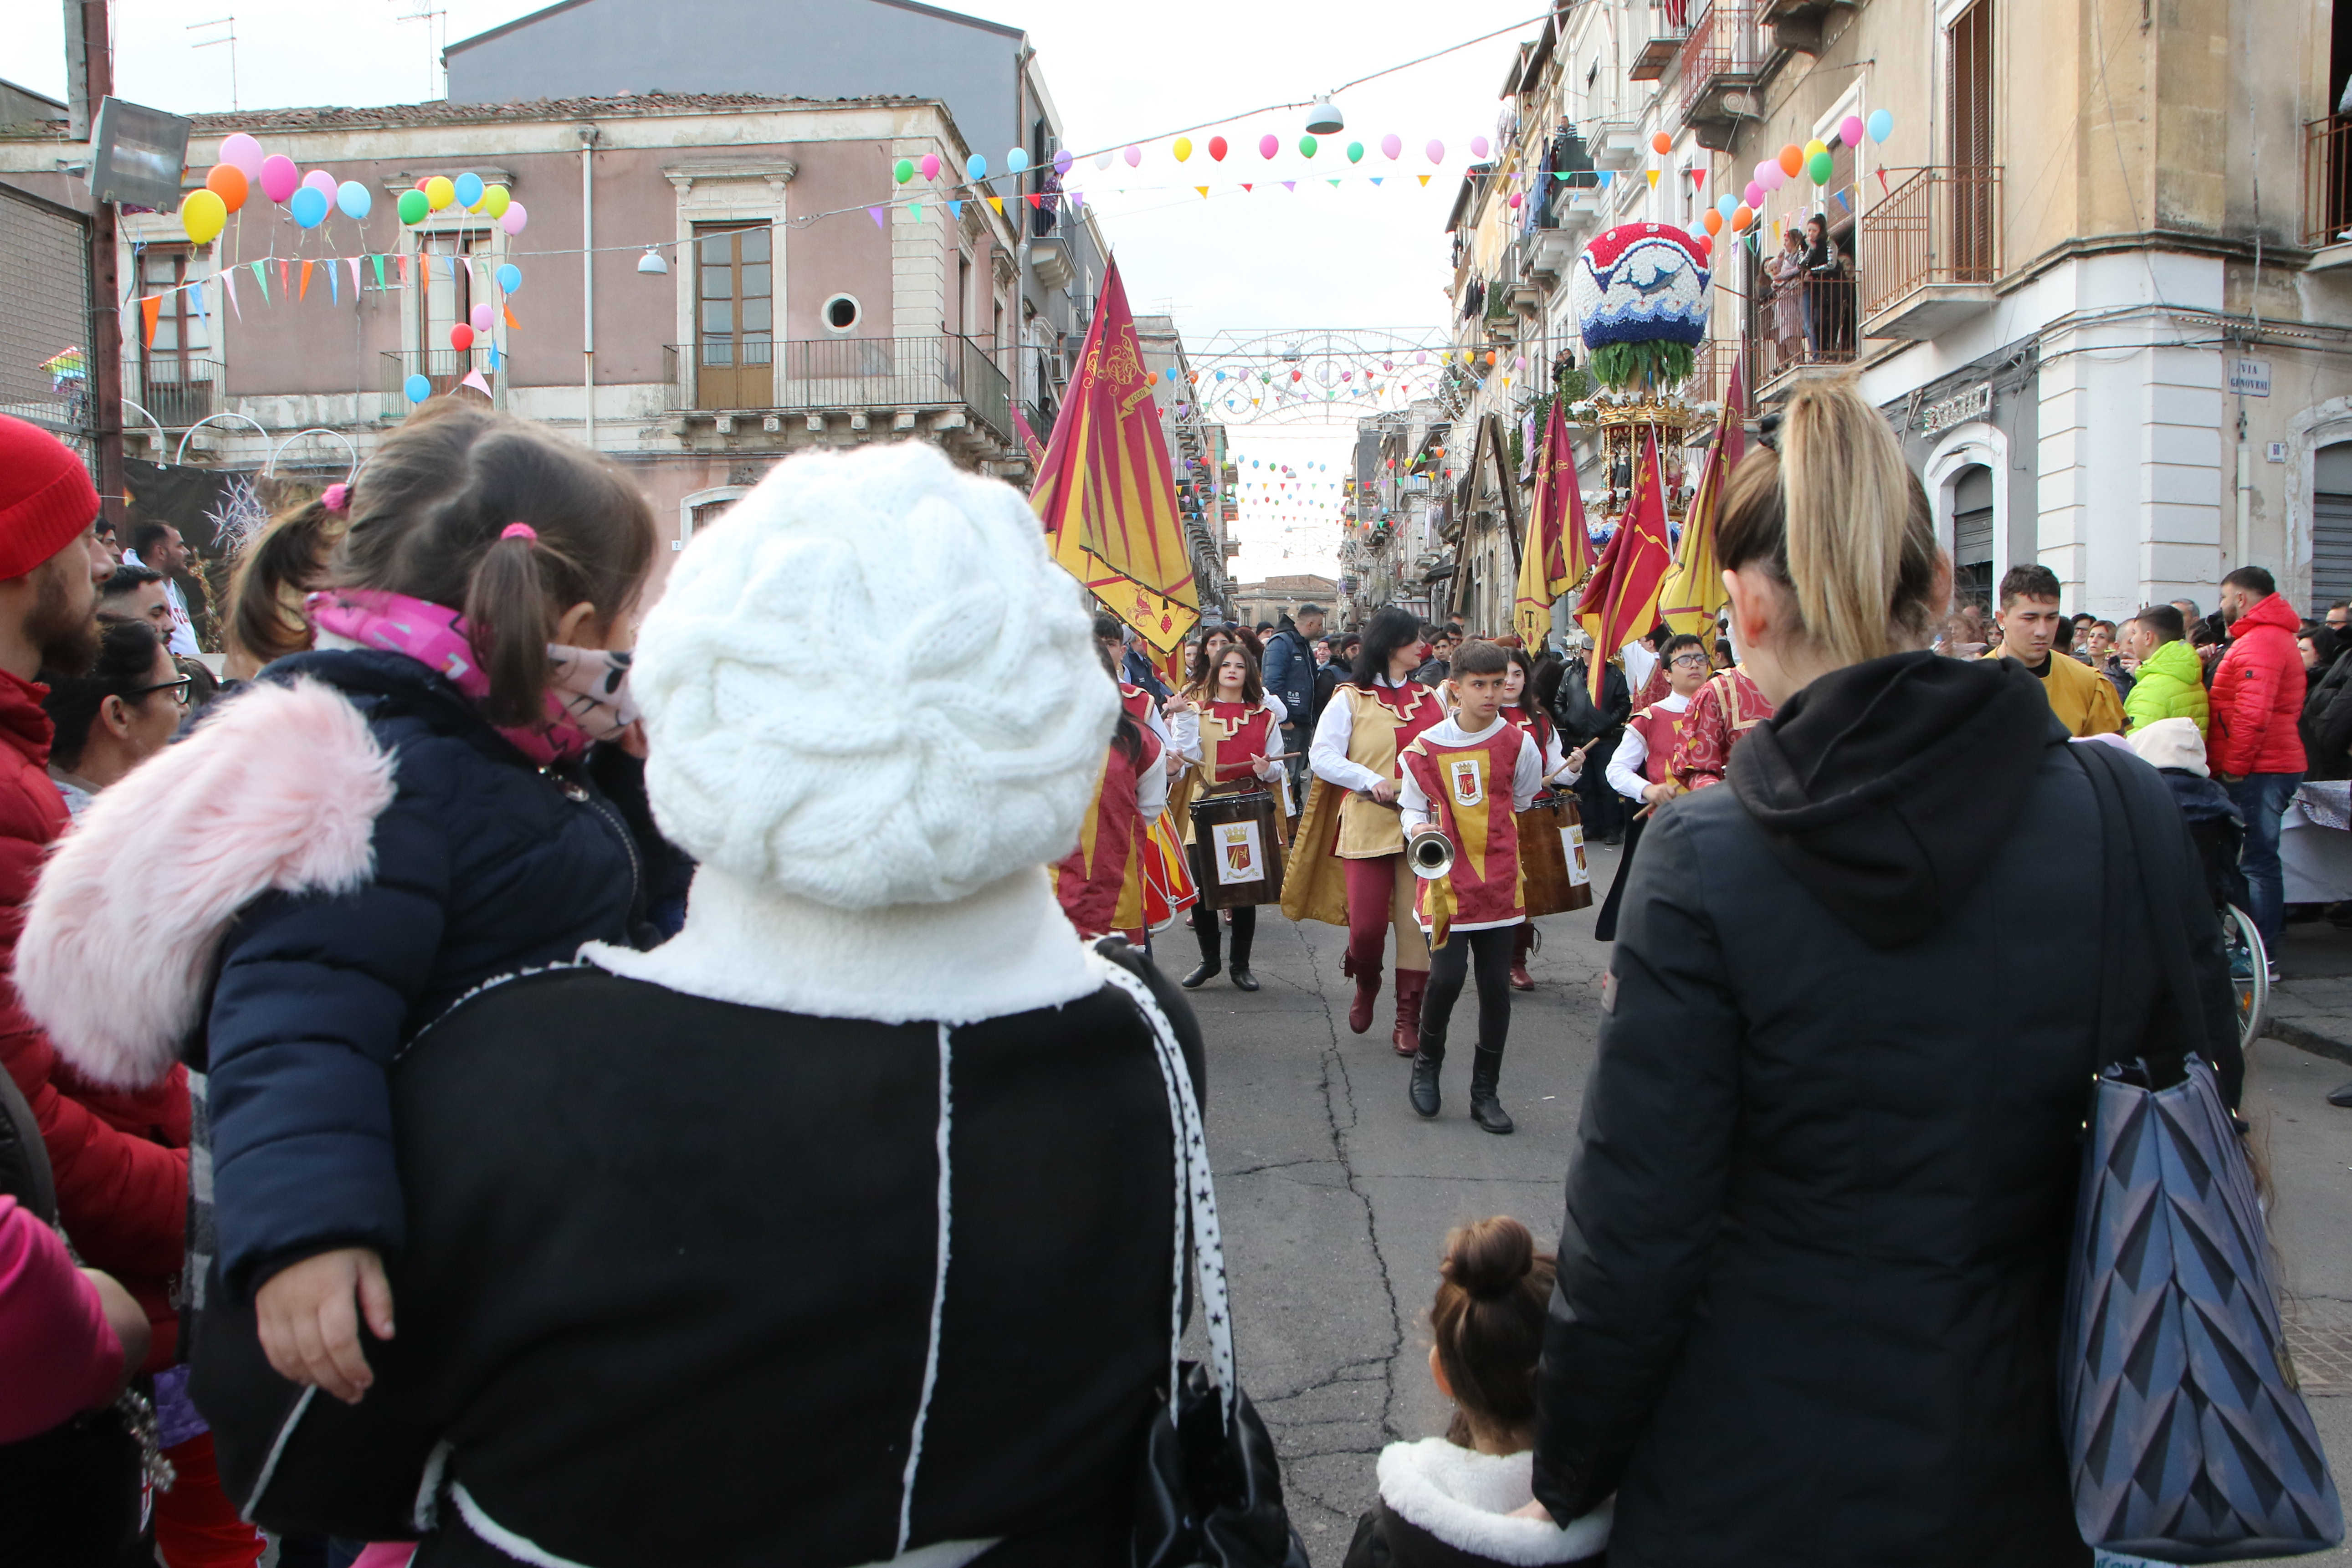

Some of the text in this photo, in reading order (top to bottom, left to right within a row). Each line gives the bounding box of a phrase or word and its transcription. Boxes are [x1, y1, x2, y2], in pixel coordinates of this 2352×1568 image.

[2241, 364, 2257, 374] VIA
[2230, 378, 2267, 390] GENOVESI
[1525, 610, 1534, 628] T
